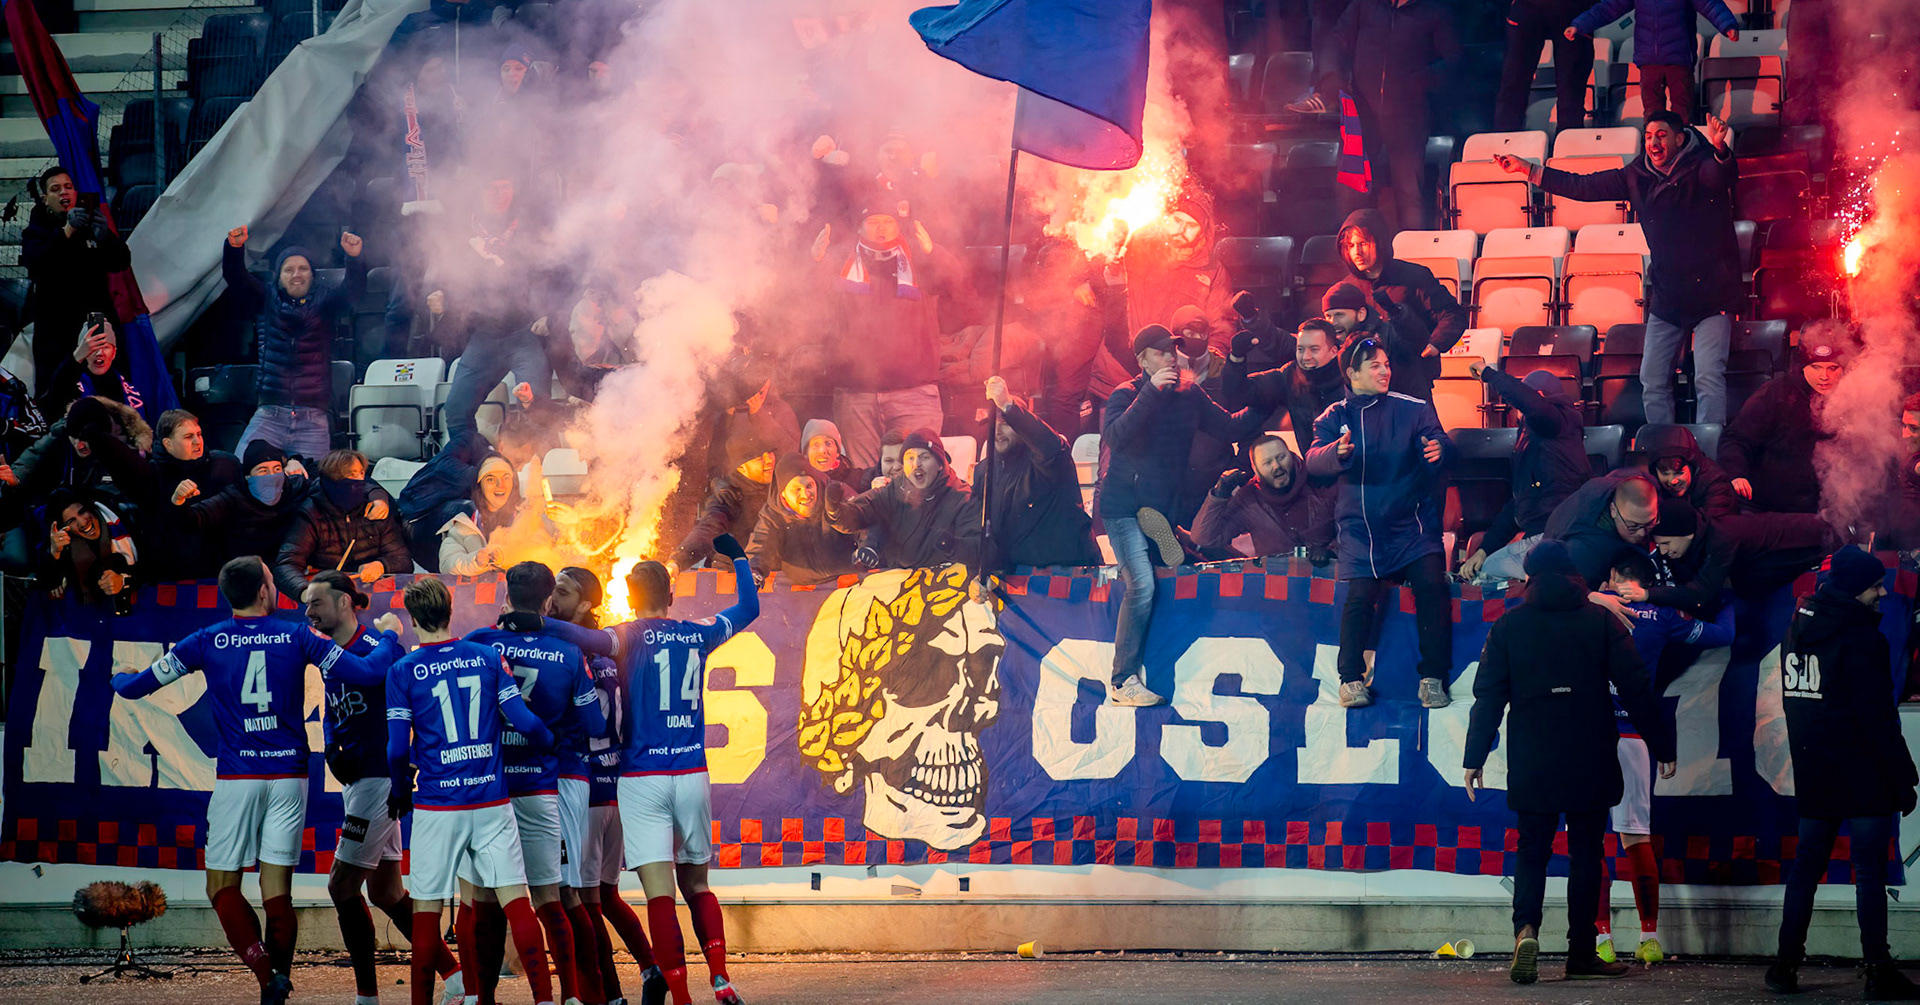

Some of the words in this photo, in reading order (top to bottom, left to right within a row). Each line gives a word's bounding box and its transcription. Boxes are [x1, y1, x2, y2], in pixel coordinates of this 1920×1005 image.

[231, 632, 292, 648] Fjordkraft
[362, 634, 380, 647] coop
[506, 646, 565, 663] Fjordkraft
[240, 650, 273, 713] 4
[653, 648, 702, 711] 14
[1550, 686, 1572, 694] umbro
[431, 675, 482, 743] 17
[244, 715, 278, 733] NATION
[667, 715, 695, 728] UDAHL
[440, 743, 494, 765] CHRISTENSEN
[648, 746, 669, 756] mot
[504, 765, 542, 774] rasisme
[440, 777, 461, 788] mot
[463, 774, 496, 786] rasisme
